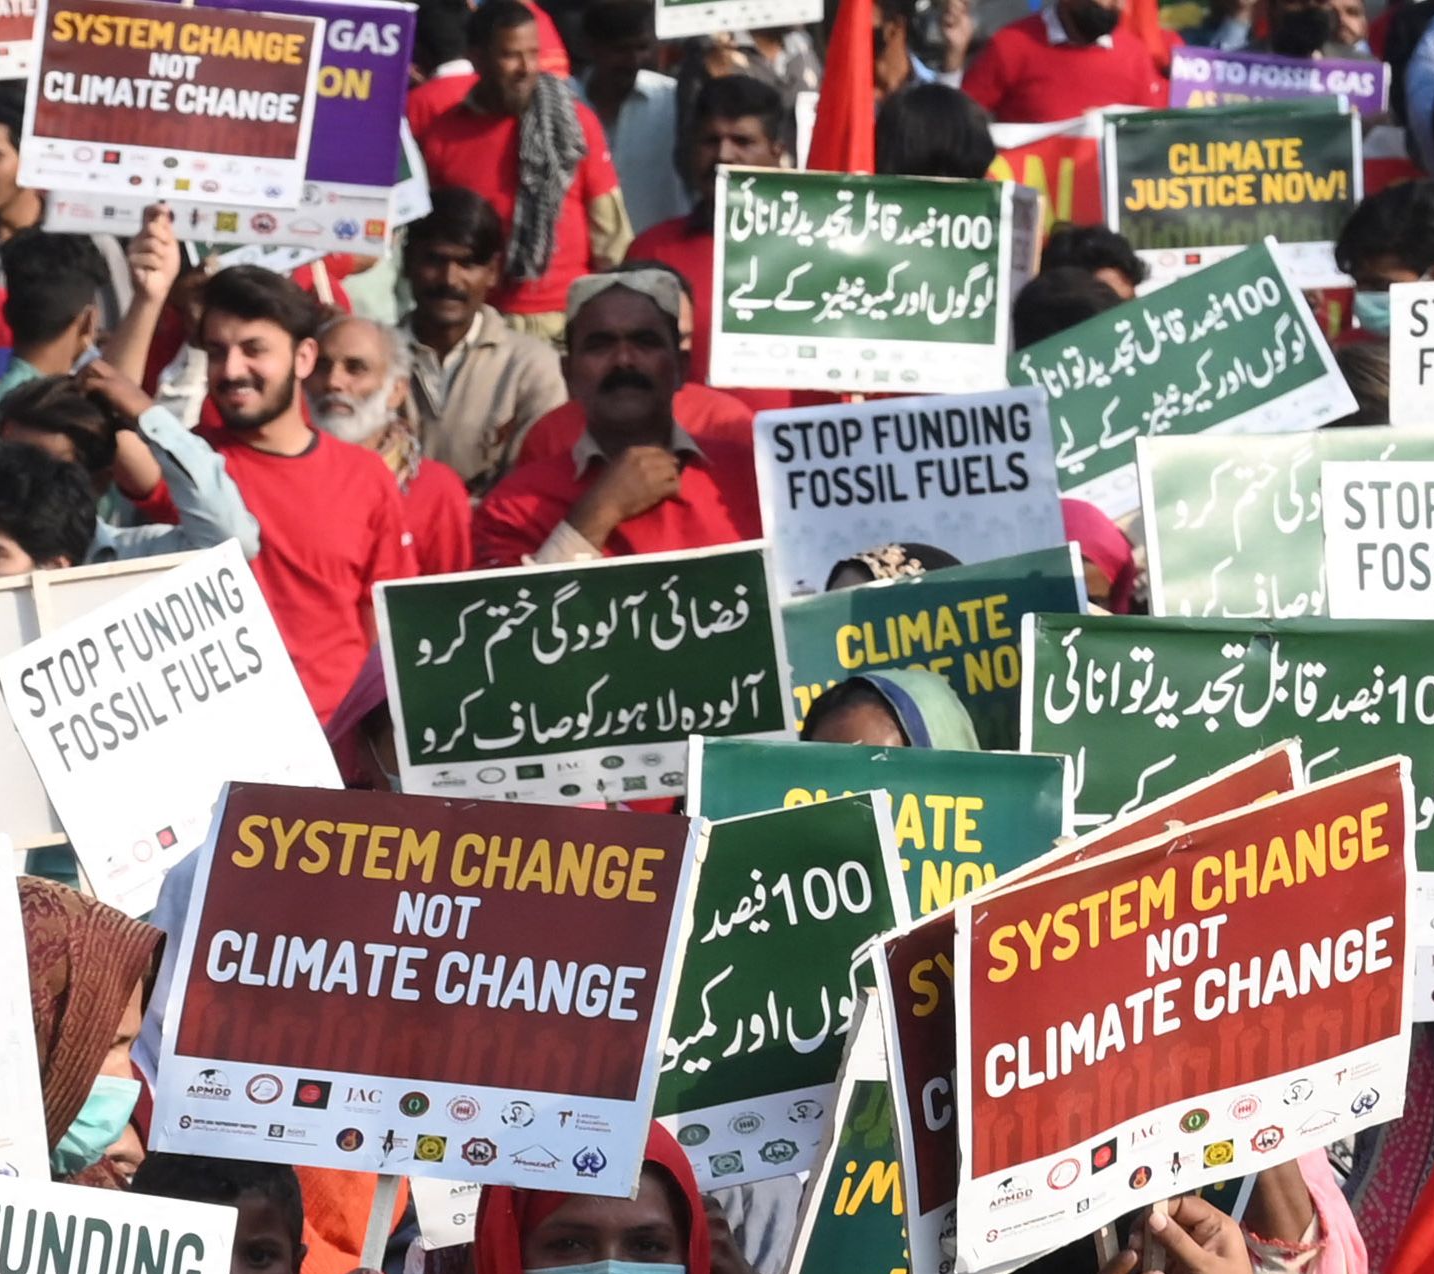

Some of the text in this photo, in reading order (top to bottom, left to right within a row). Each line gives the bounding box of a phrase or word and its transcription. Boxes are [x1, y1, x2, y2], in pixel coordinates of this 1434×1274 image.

[52, 12, 305, 64] SYSTEM CHANGE
[149, 52, 202, 81] NOT
[329, 19, 401, 56] GAS
[43, 71, 297, 124] CLIMATE CHANGE
[1173, 48, 1375, 96] NO TO FOSSIL GAS
[1167, 138, 1303, 176] CLIMATE
[1126, 166, 1349, 211] JUSTICE NOW!
[937, 213, 992, 251] 100
[1222, 276, 1280, 323] 100
[773, 402, 1033, 464] STOP FUNDING
[788, 451, 1030, 509] FOSSIL FUELS
[18, 564, 247, 719] STOP FUNDING
[533, 574, 750, 665] فضائی آلودگی
[836, 592, 1011, 670] CLIMATE
[47, 627, 265, 774] FOSSIL FUELS
[1316, 664, 1384, 725] فیصد
[230, 814, 665, 902] SYSTEM CHANGE
[392, 890, 481, 942] NOT
[700, 860, 872, 944] 100 فیصد
[986, 801, 1390, 984] SYSTEM CHANGE
[203, 929, 646, 1022] CLIMATE CHANGE
[1145, 912, 1229, 978] NOT
[722, 990, 779, 1058] اور
[983, 978, 1184, 1099] CLIMATE
[1192, 917, 1395, 1022] CHANGE
